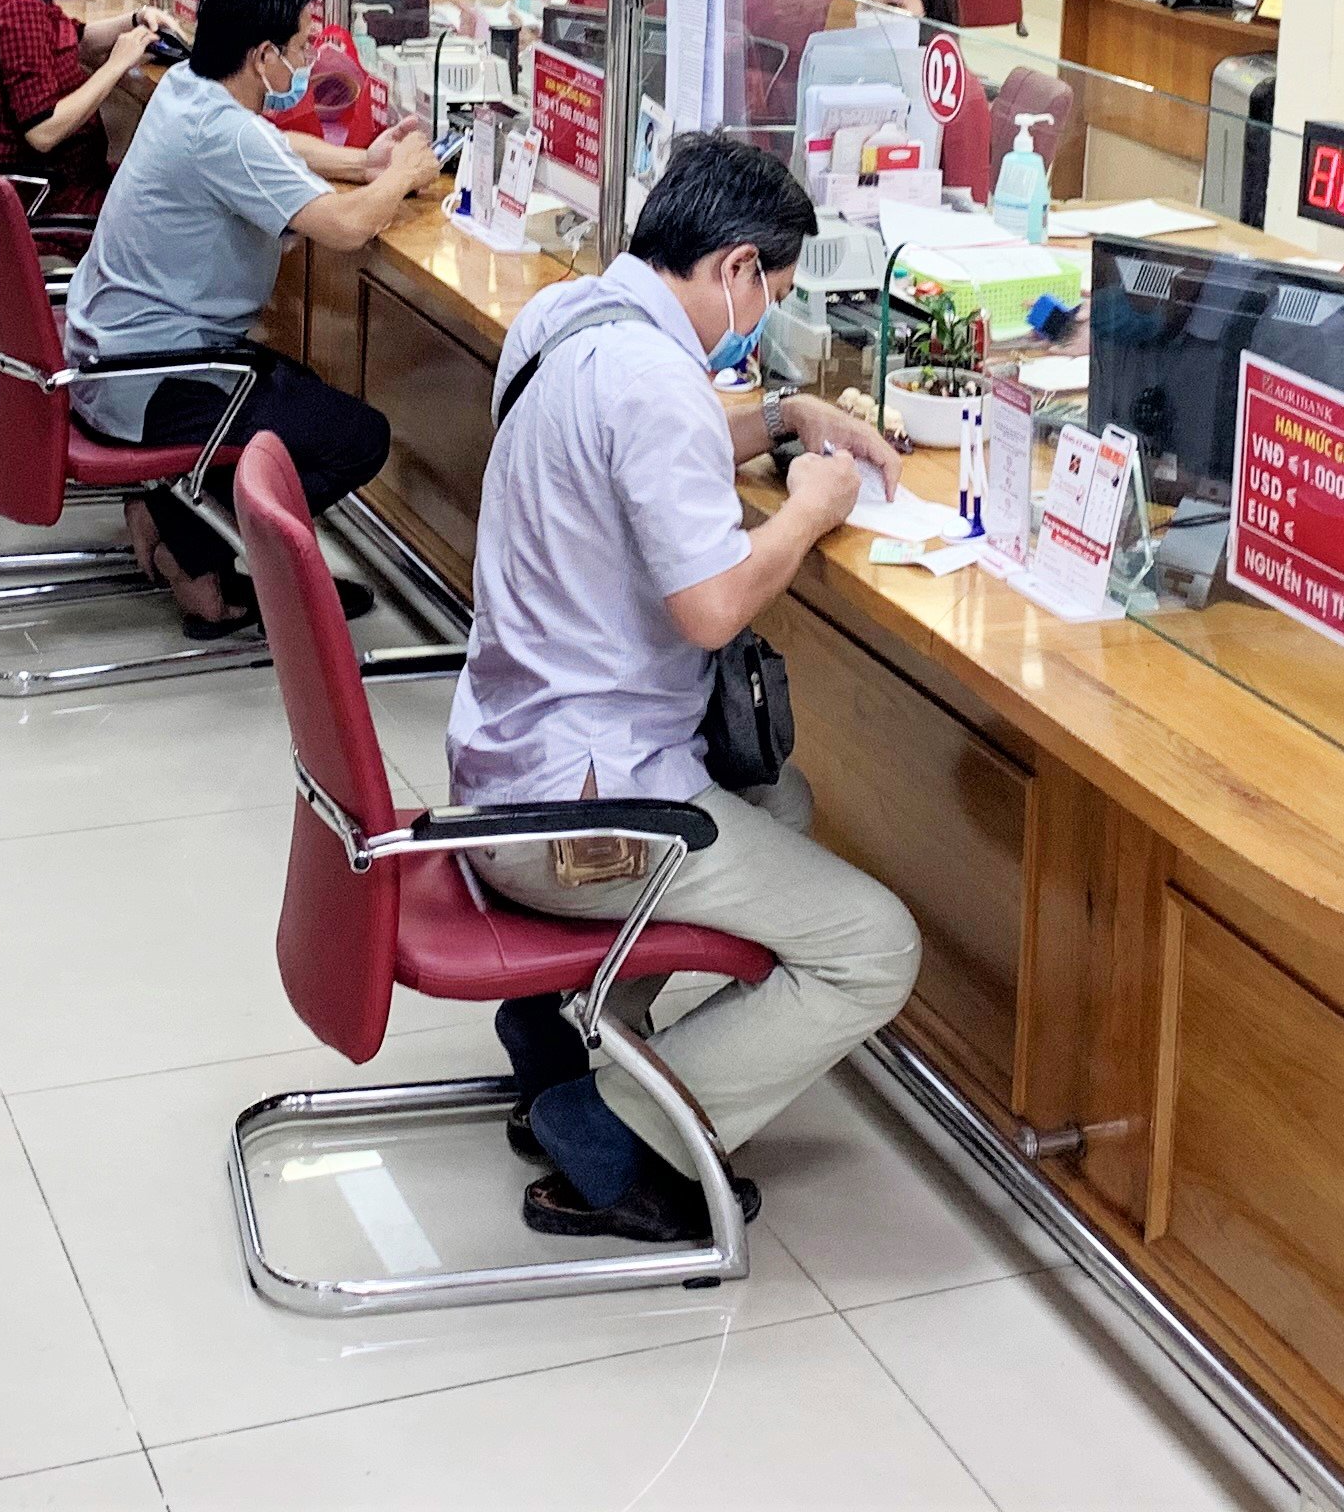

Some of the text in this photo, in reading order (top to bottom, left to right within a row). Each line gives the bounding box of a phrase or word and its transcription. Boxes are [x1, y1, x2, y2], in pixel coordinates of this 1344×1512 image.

[928, 48, 957, 108] 02
[1252, 433, 1285, 469] VNĐ
[1275, 414, 1302, 443] HẠN
[1306, 429, 1332, 459] MỨC
[1249, 464, 1282, 502] USD
[1247, 497, 1280, 536] EUR
[1244, 545, 1302, 597] NGUYỄN
[1306, 577, 1328, 618] THỊ
